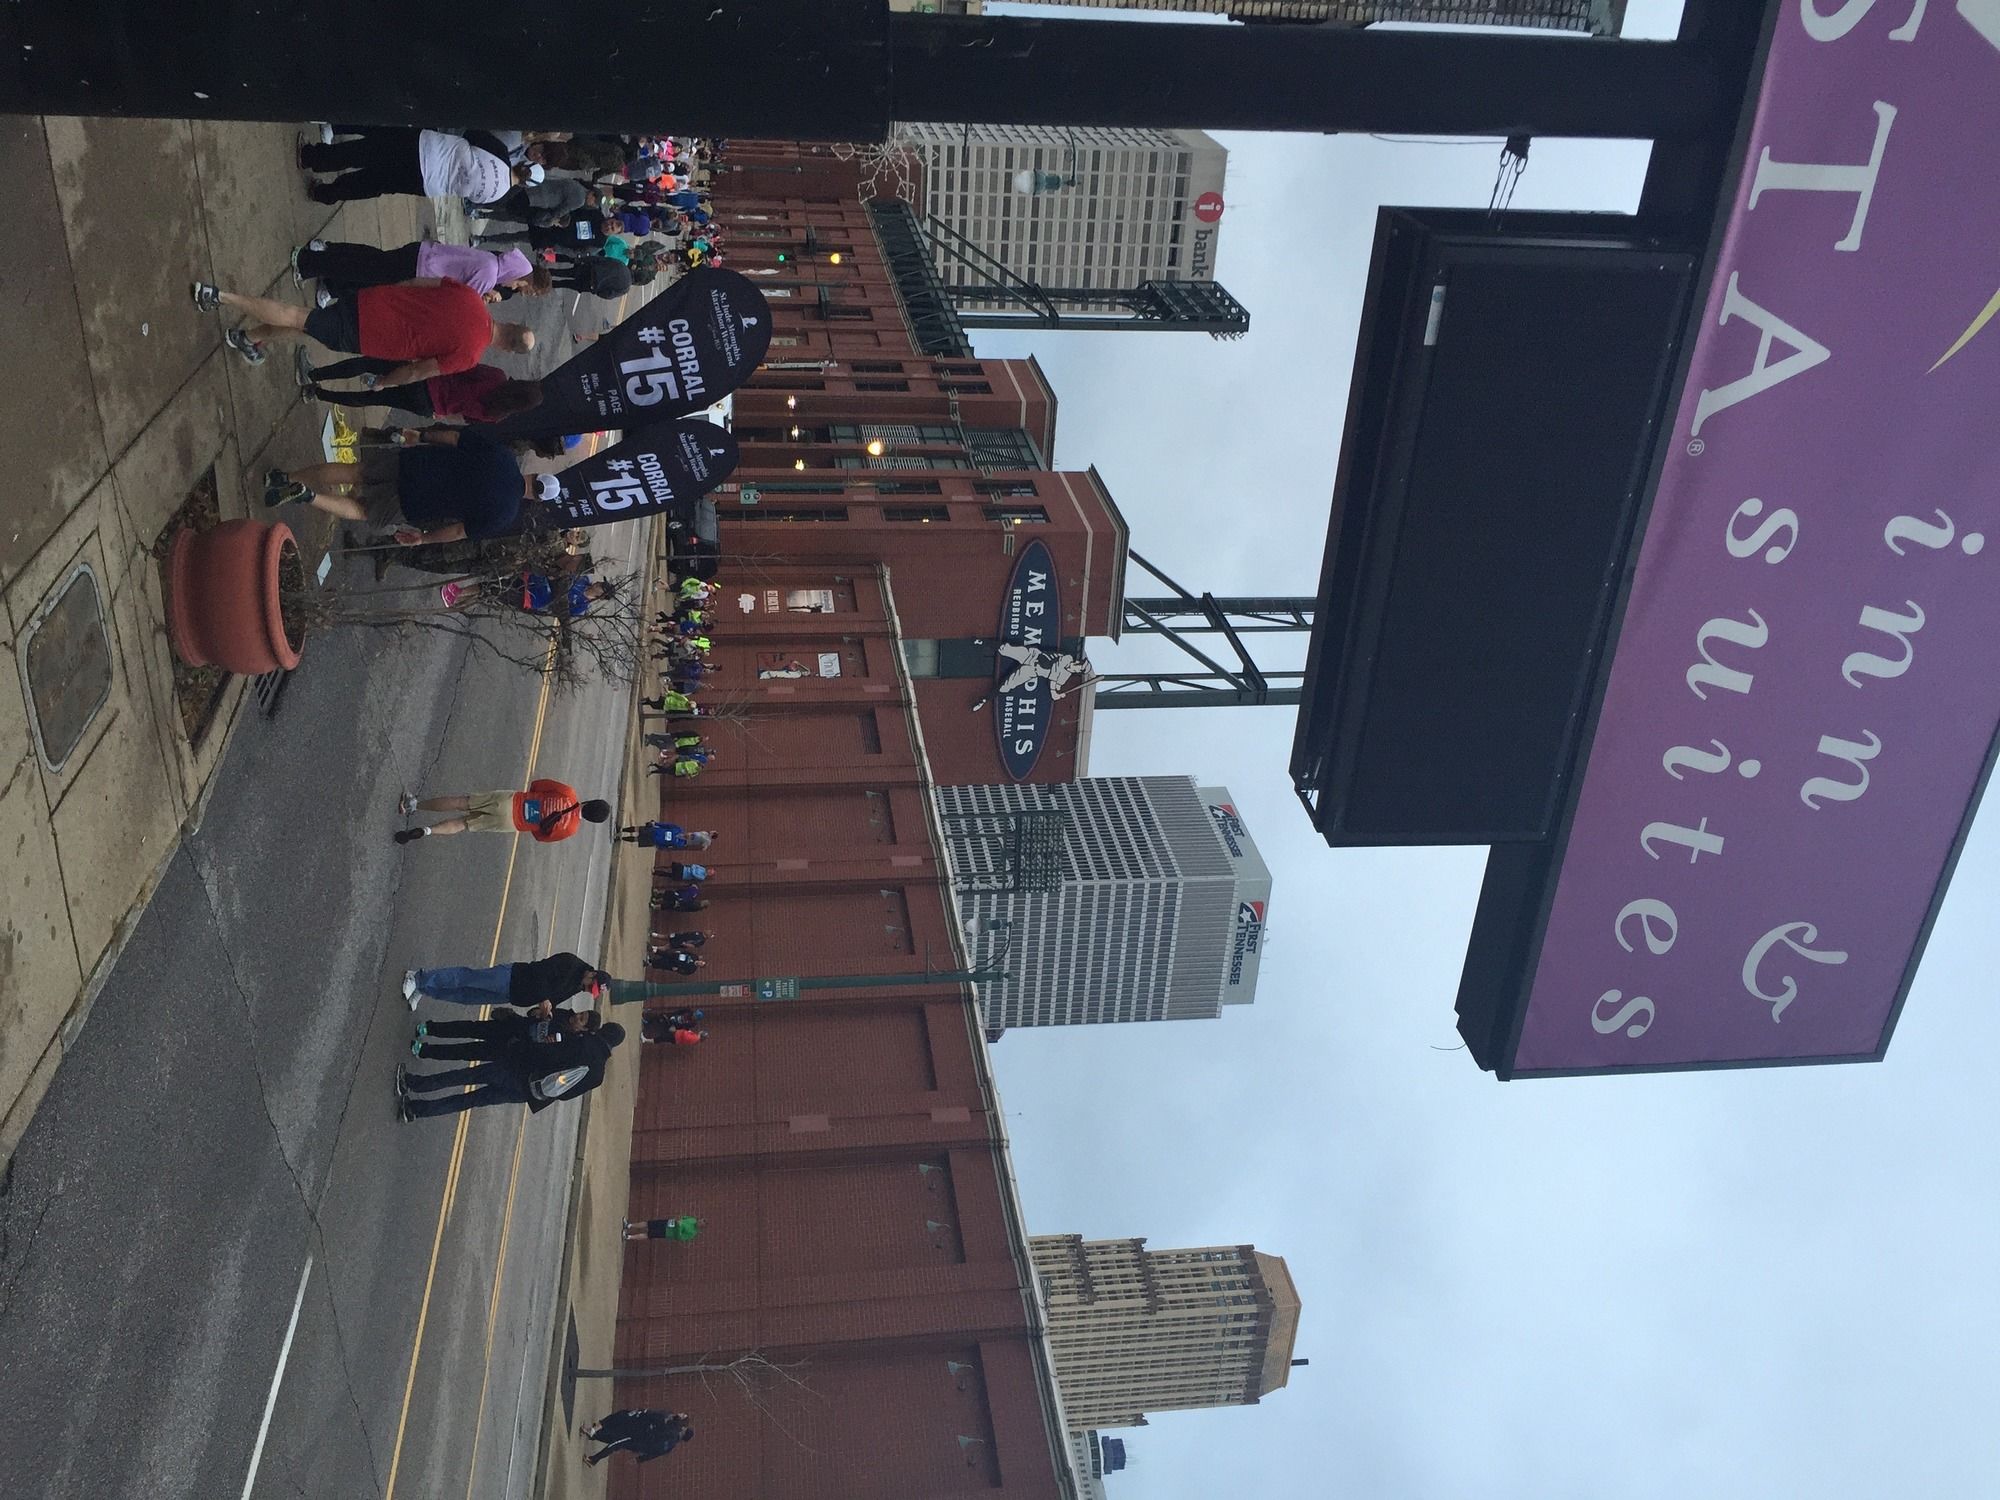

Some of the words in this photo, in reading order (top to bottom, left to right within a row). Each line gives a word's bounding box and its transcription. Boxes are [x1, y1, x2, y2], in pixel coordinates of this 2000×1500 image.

[1191, 229, 1213, 278] bank
[719, 292, 728, 303] St.
[722, 304, 733, 323] Jude
[711, 289, 725, 329] Marathon
[721, 330, 735, 366] Weekend
[728, 324, 741, 360] Memphis
[620, 326, 680, 407] #15
[668, 318, 706, 401] CORRAL
[607, 389, 622, 414] PACE
[589, 459, 649, 511] #15
[637, 453, 674, 504] CORRAL
[578, 499, 594, 516] PACE
[1009, 588, 1022, 636] REDBIRDS
[1800, 508, 1984, 810] inn
[1002, 696, 1014, 739] BASEBALL
[1591, 498, 1799, 1038] suites
[1216, 818, 1242, 858] TENNESSEE
[1229, 818, 1244, 837] FIRST
[1229, 924, 1247, 985] TENNESSEE
[1246, 924, 1261, 954] FIRST
[1742, 921, 1848, 1023] &
